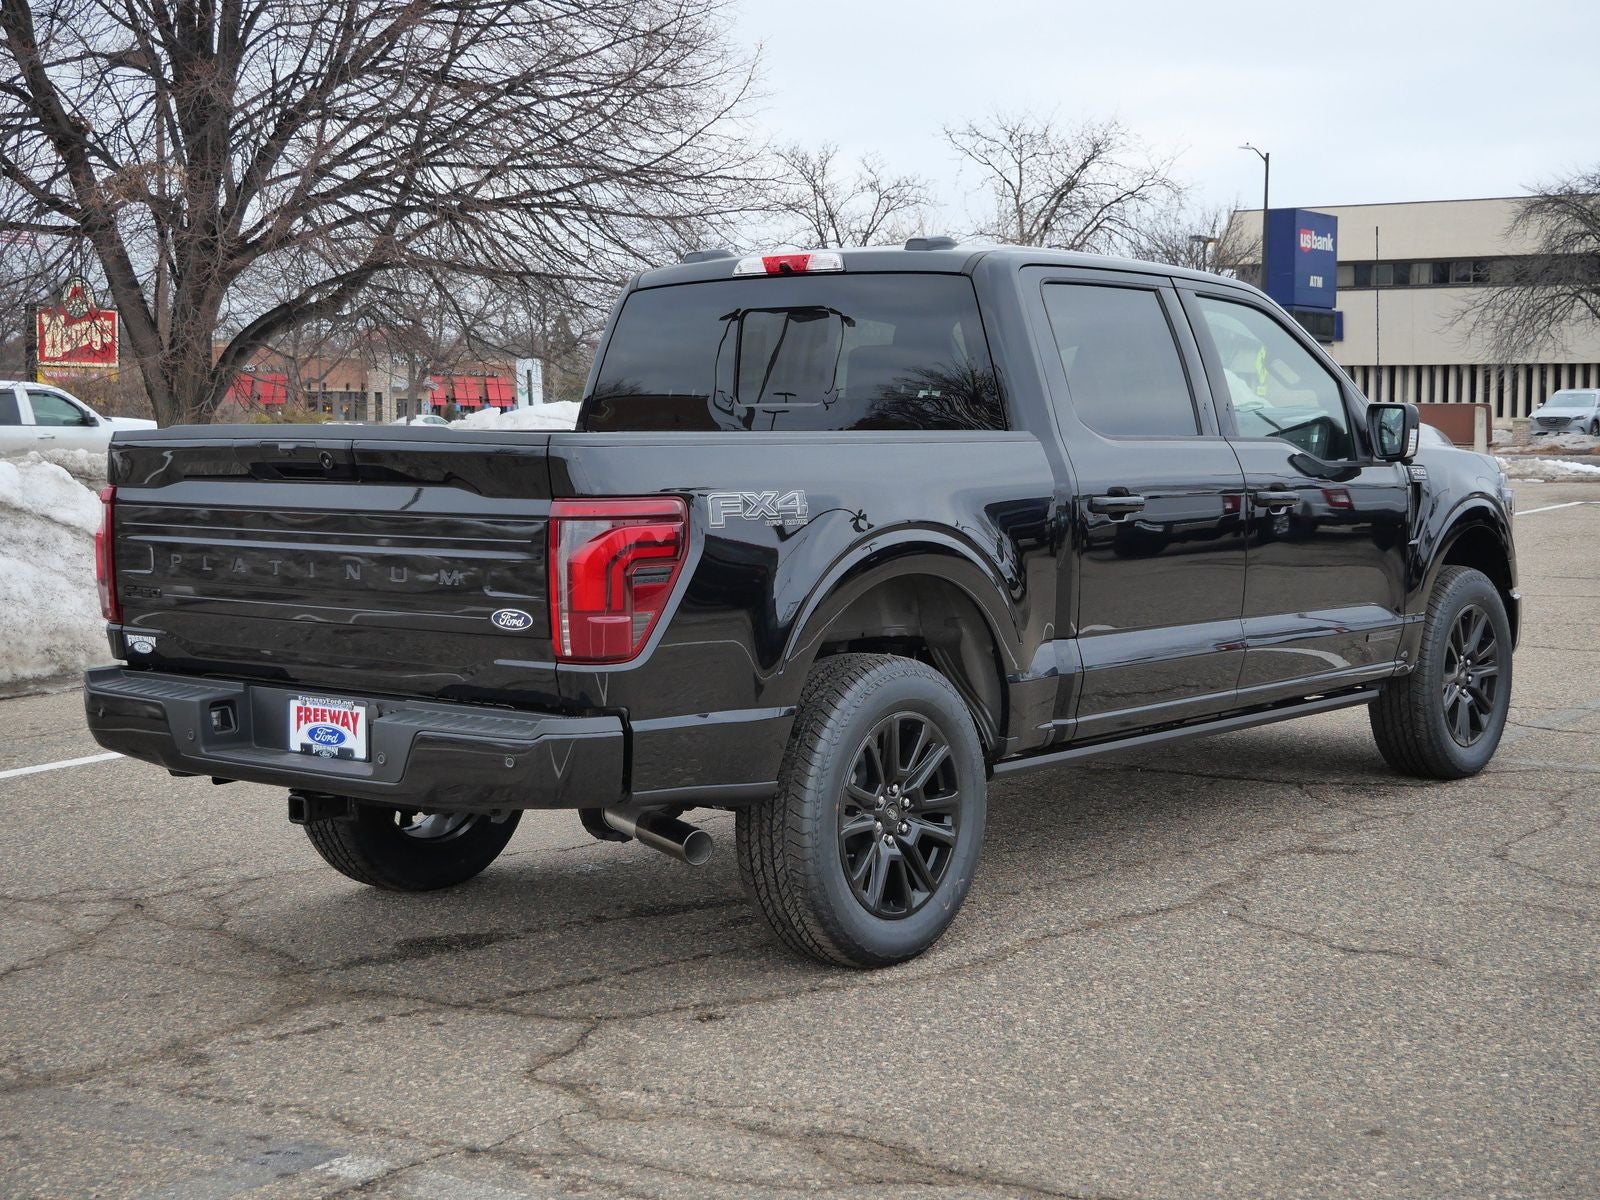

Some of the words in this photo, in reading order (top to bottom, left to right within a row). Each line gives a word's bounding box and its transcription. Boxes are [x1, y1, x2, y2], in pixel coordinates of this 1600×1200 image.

[1310, 275, 1323, 288] ATM
[707, 489, 809, 529] FX4
[170, 553, 460, 586] PLATINUM
[499, 611, 525, 627] Ford
[296, 705, 360, 740] FREEWAY
[314, 727, 339, 743] Ford
